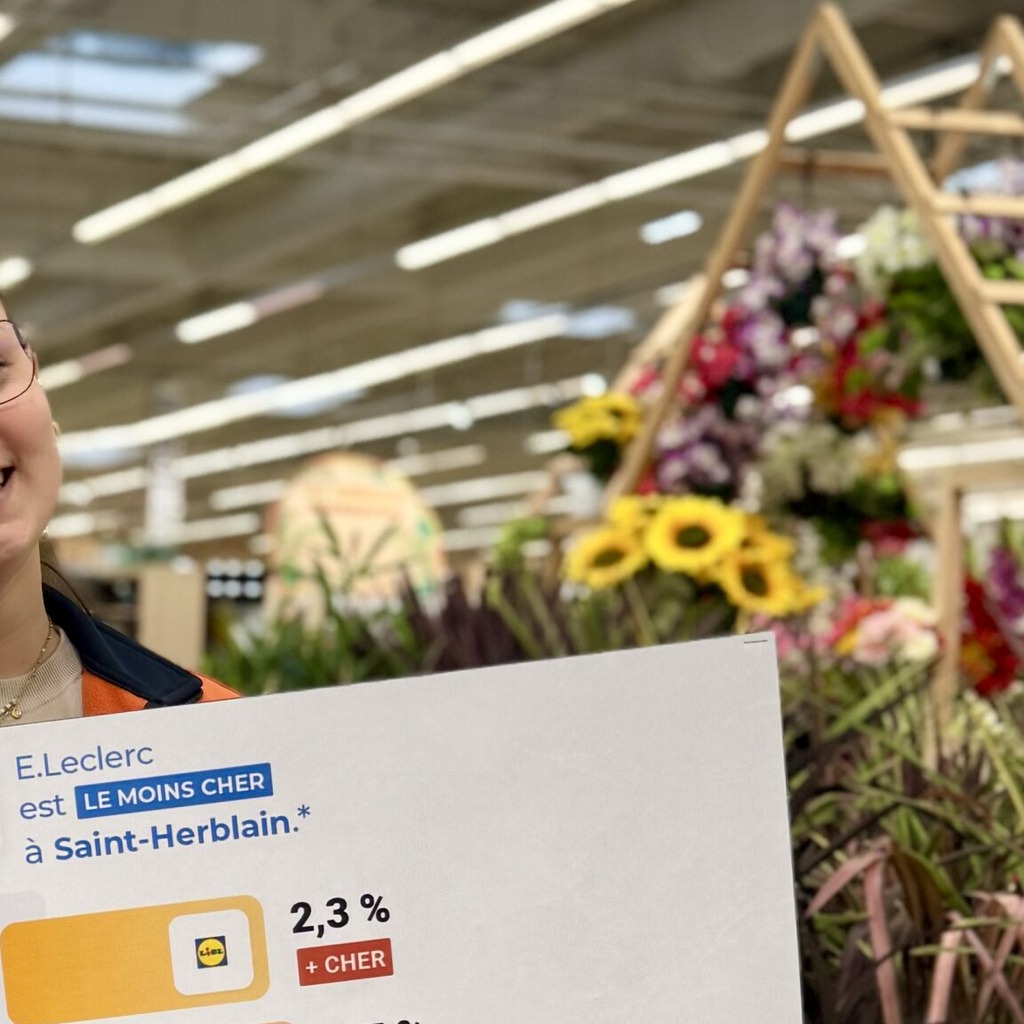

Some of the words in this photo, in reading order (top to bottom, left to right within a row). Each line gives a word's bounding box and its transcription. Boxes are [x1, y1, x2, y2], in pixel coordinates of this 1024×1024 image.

[16, 745, 153, 780] E.Leclerc
[20, 795, 67, 820] est
[84, 791, 112, 810] LE
[117, 781, 194, 806] MOINS
[201, 773, 264, 795] CHER
[25, 838, 43, 864] à
[290, 897, 349, 939] 2,3
[360, 894, 390, 923] %
[305, 961, 318, 974] +
[325, 950, 386, 973] CHER
